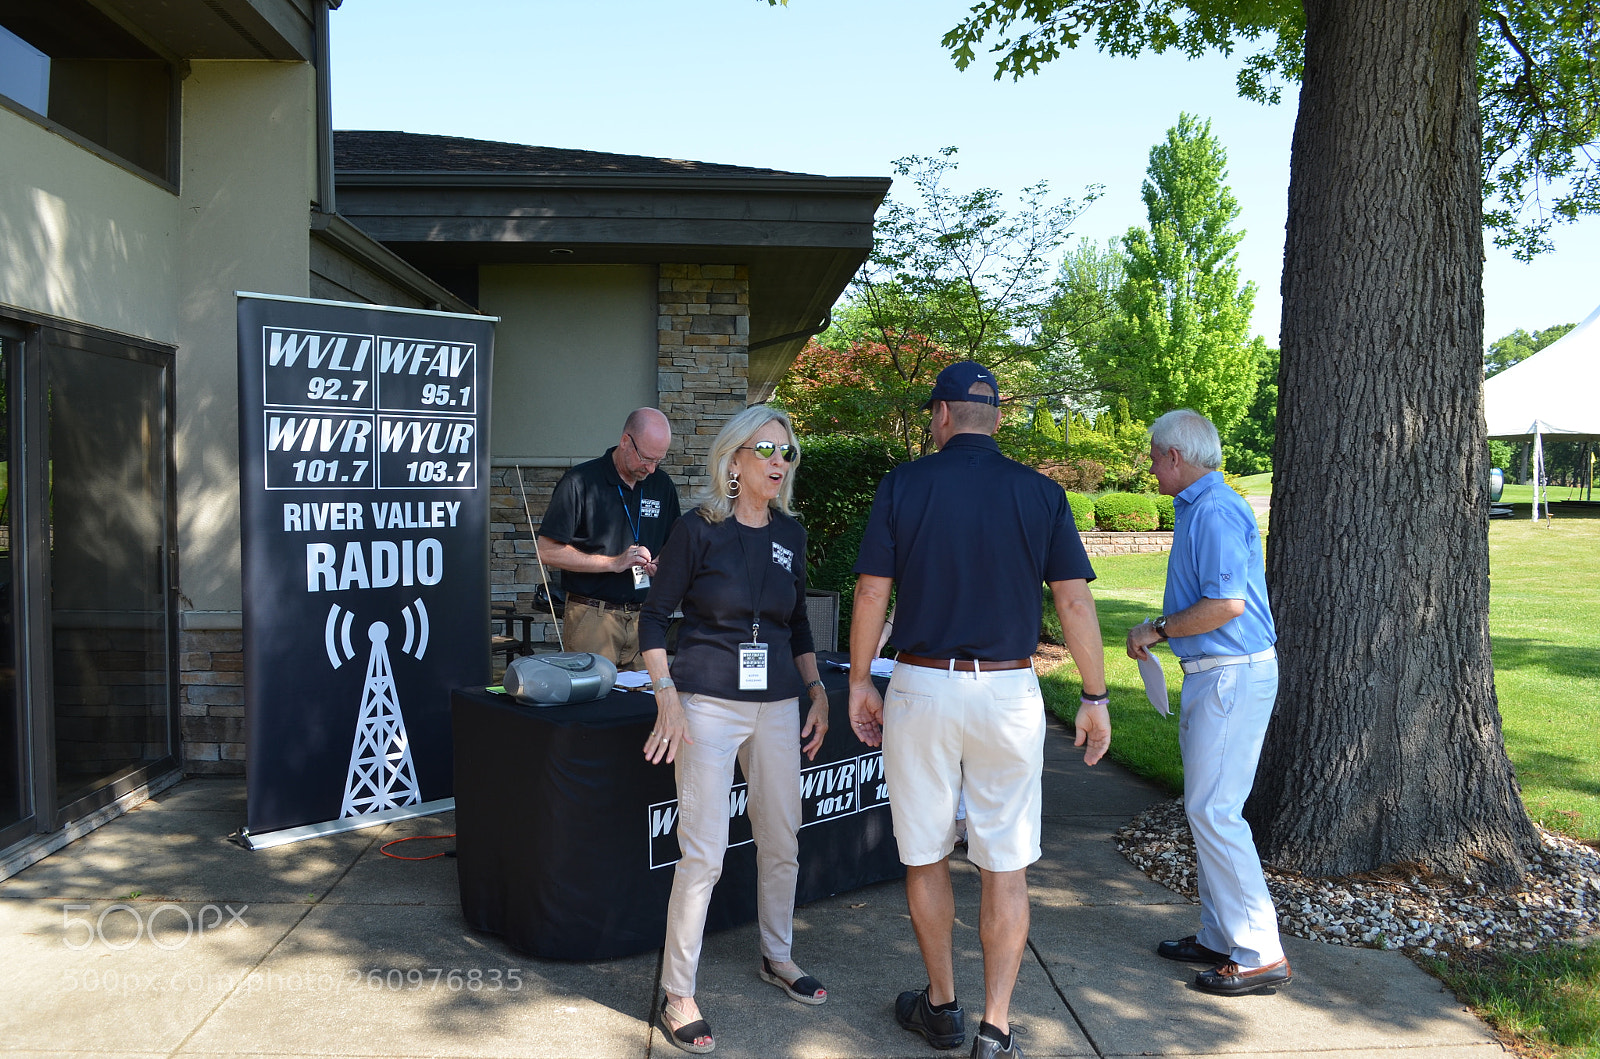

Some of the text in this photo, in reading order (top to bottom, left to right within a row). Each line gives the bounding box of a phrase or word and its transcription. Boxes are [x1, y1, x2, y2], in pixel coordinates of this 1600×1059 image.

[268, 332, 372, 372] WVLI
[380, 341, 474, 378] WFAV
[307, 377, 369, 402] 92.7
[421, 383, 471, 407] 95.1
[268, 417, 372, 453] WIVR
[380, 420, 474, 454] WYUR
[293, 459, 369, 482] 101.7
[406, 461, 471, 482] 103.7
[283, 501, 461, 532] RIVER VALLEY
[306, 537, 443, 592] RADIO
[800, 763, 856, 799] WIVR
[816, 792, 854, 817] 101.7
